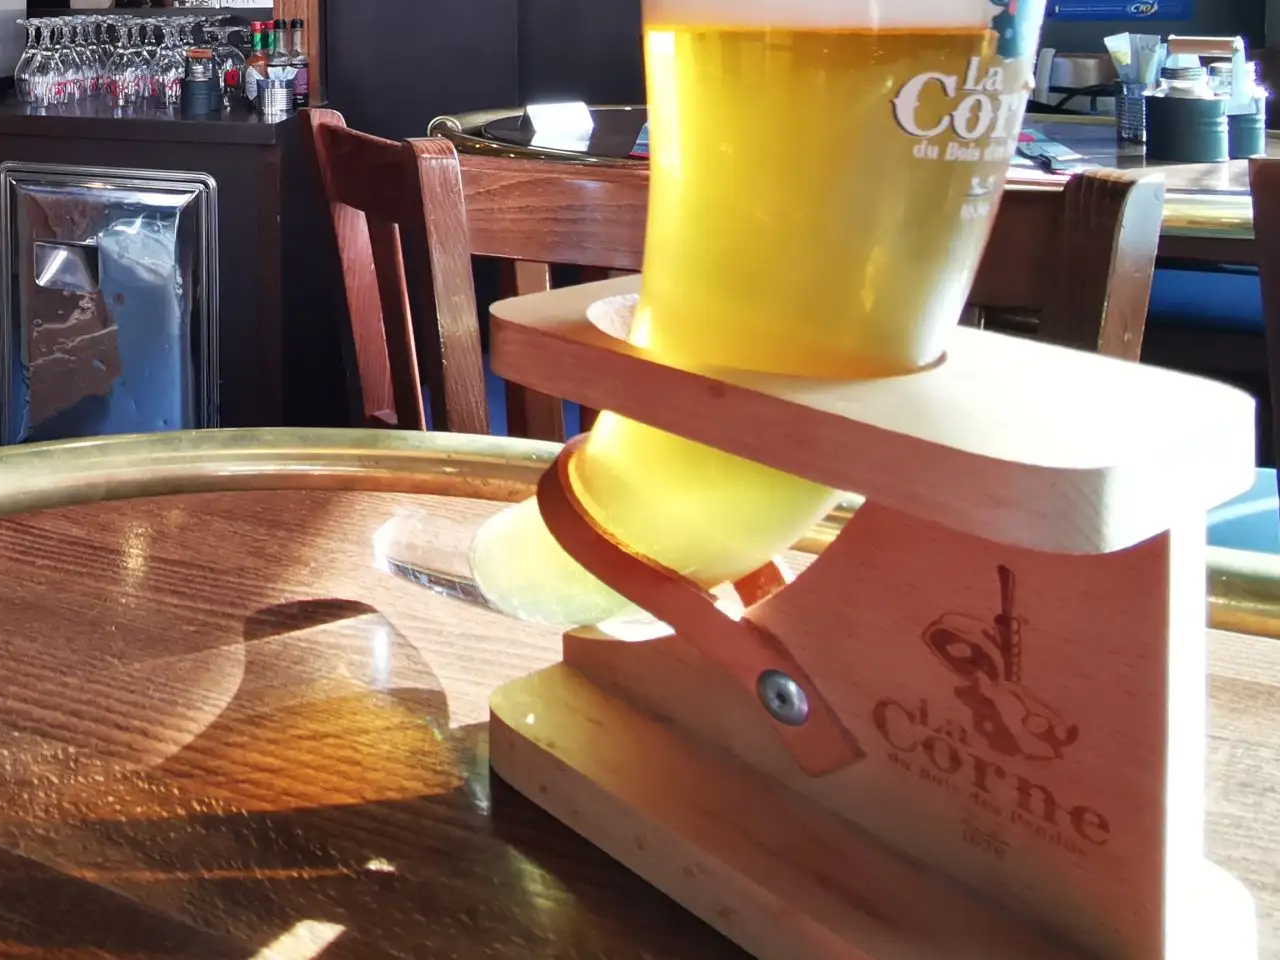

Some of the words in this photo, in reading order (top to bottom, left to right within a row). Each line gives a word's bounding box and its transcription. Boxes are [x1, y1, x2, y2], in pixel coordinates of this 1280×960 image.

[964, 56, 1004, 91] La
[892, 71, 1029, 140] Cor
[912, 141, 940, 159] du
[943, 142, 981, 161] Bois
[872, 696, 1111, 846] Corne
